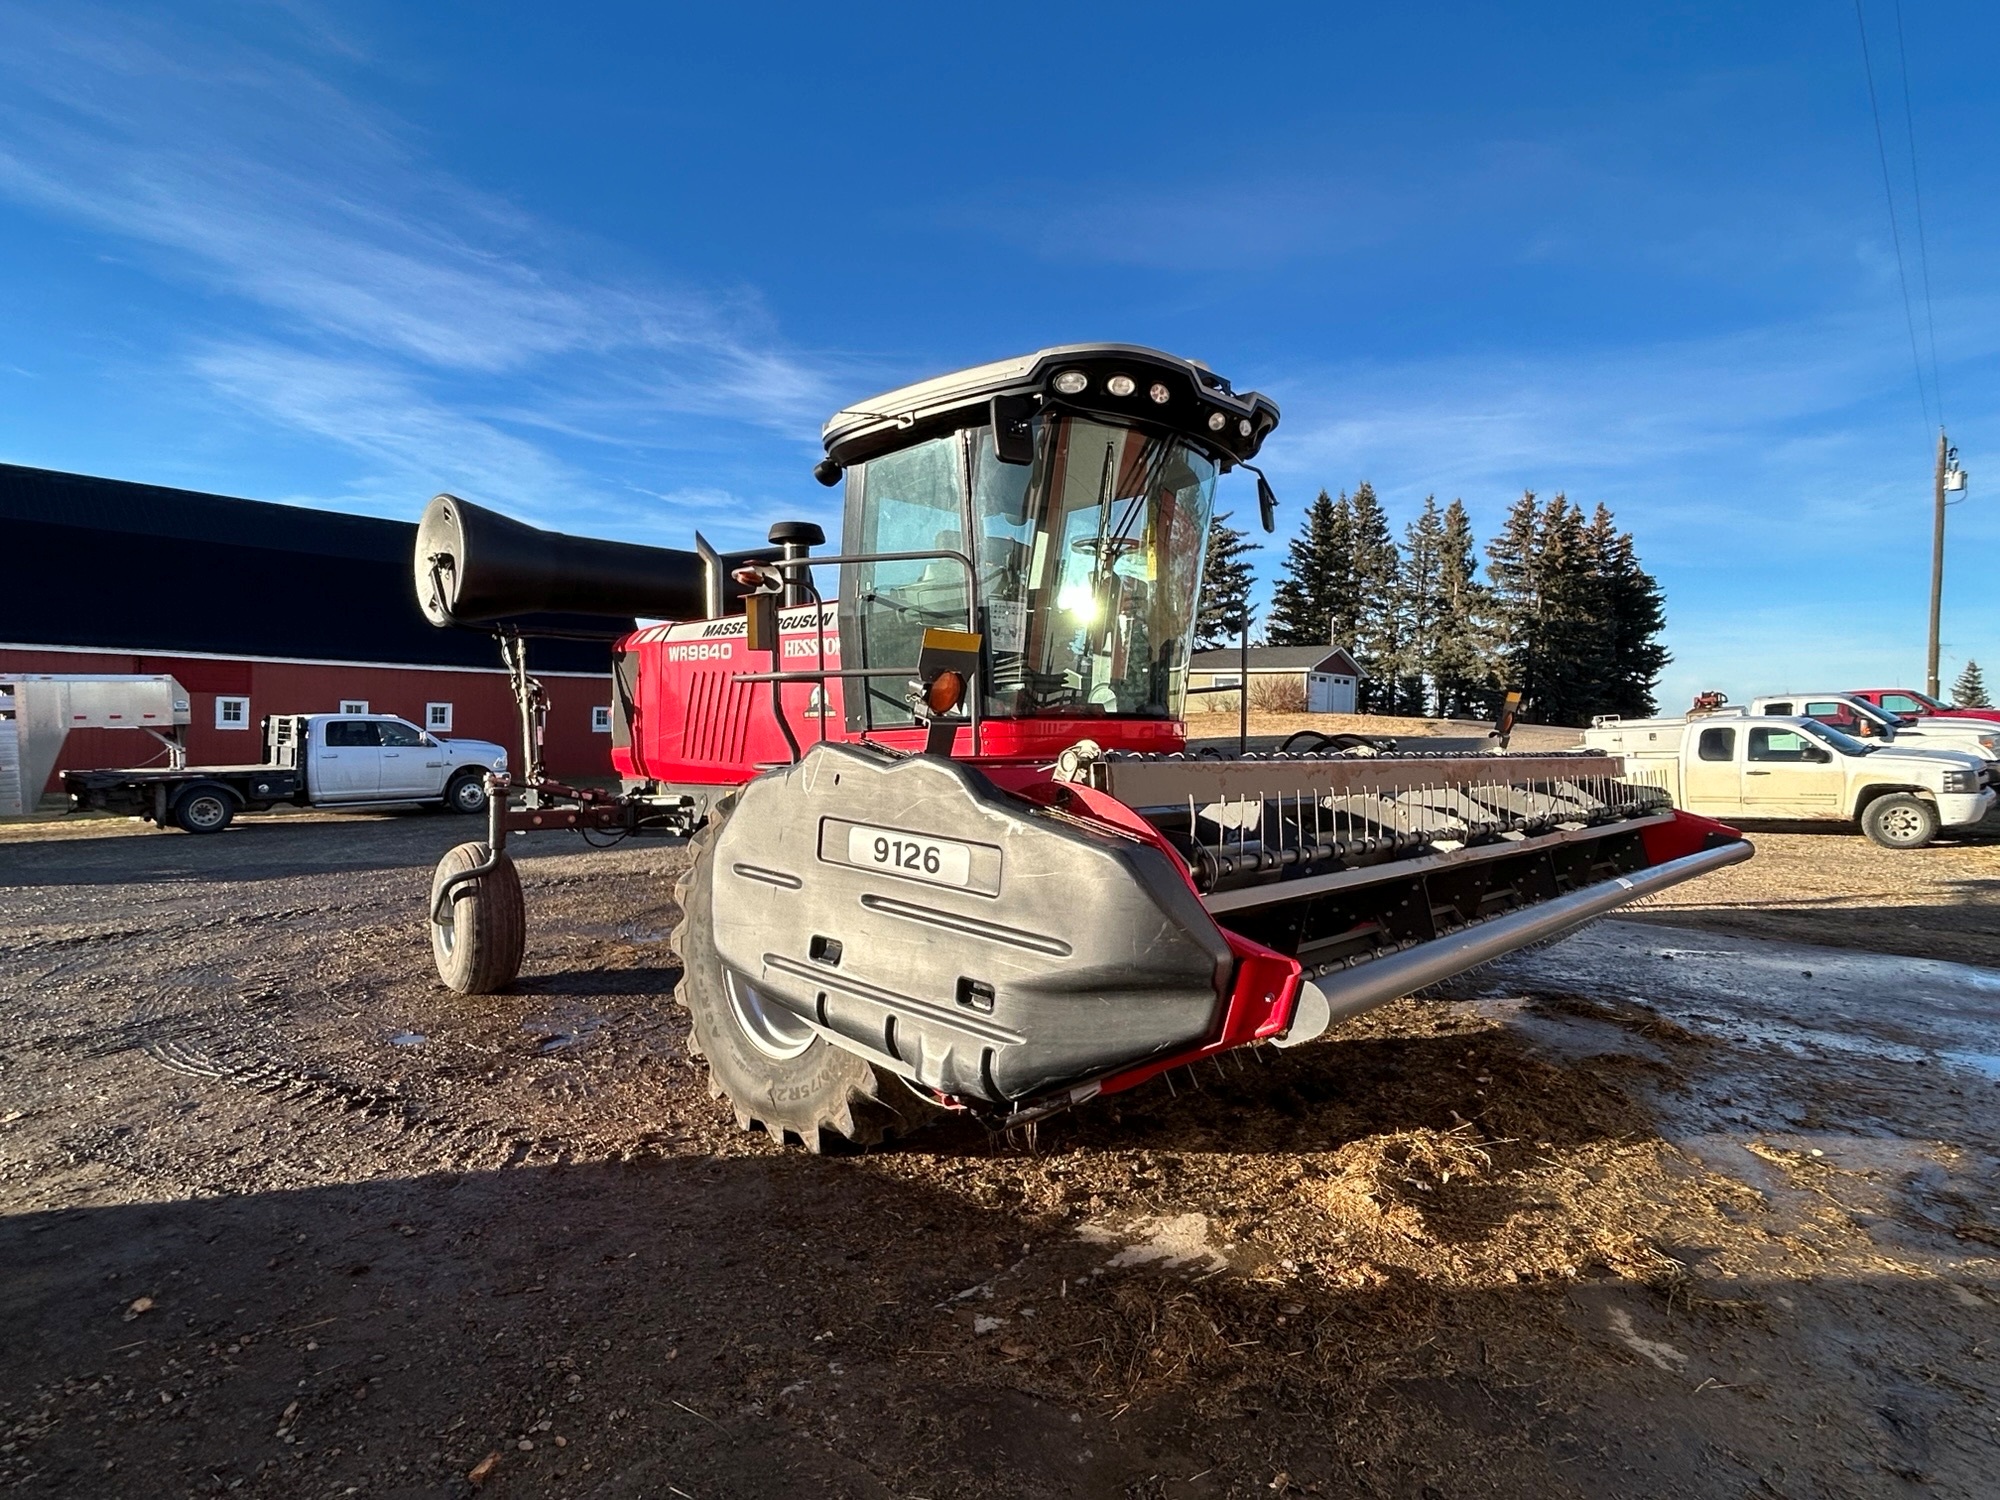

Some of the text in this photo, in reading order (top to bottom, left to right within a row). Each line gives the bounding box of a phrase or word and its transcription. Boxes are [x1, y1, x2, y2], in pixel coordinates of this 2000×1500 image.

[702, 612, 834, 638] MASSE GUSON
[668, 642, 733, 662] WR9840
[874, 837, 940, 874] 9126
